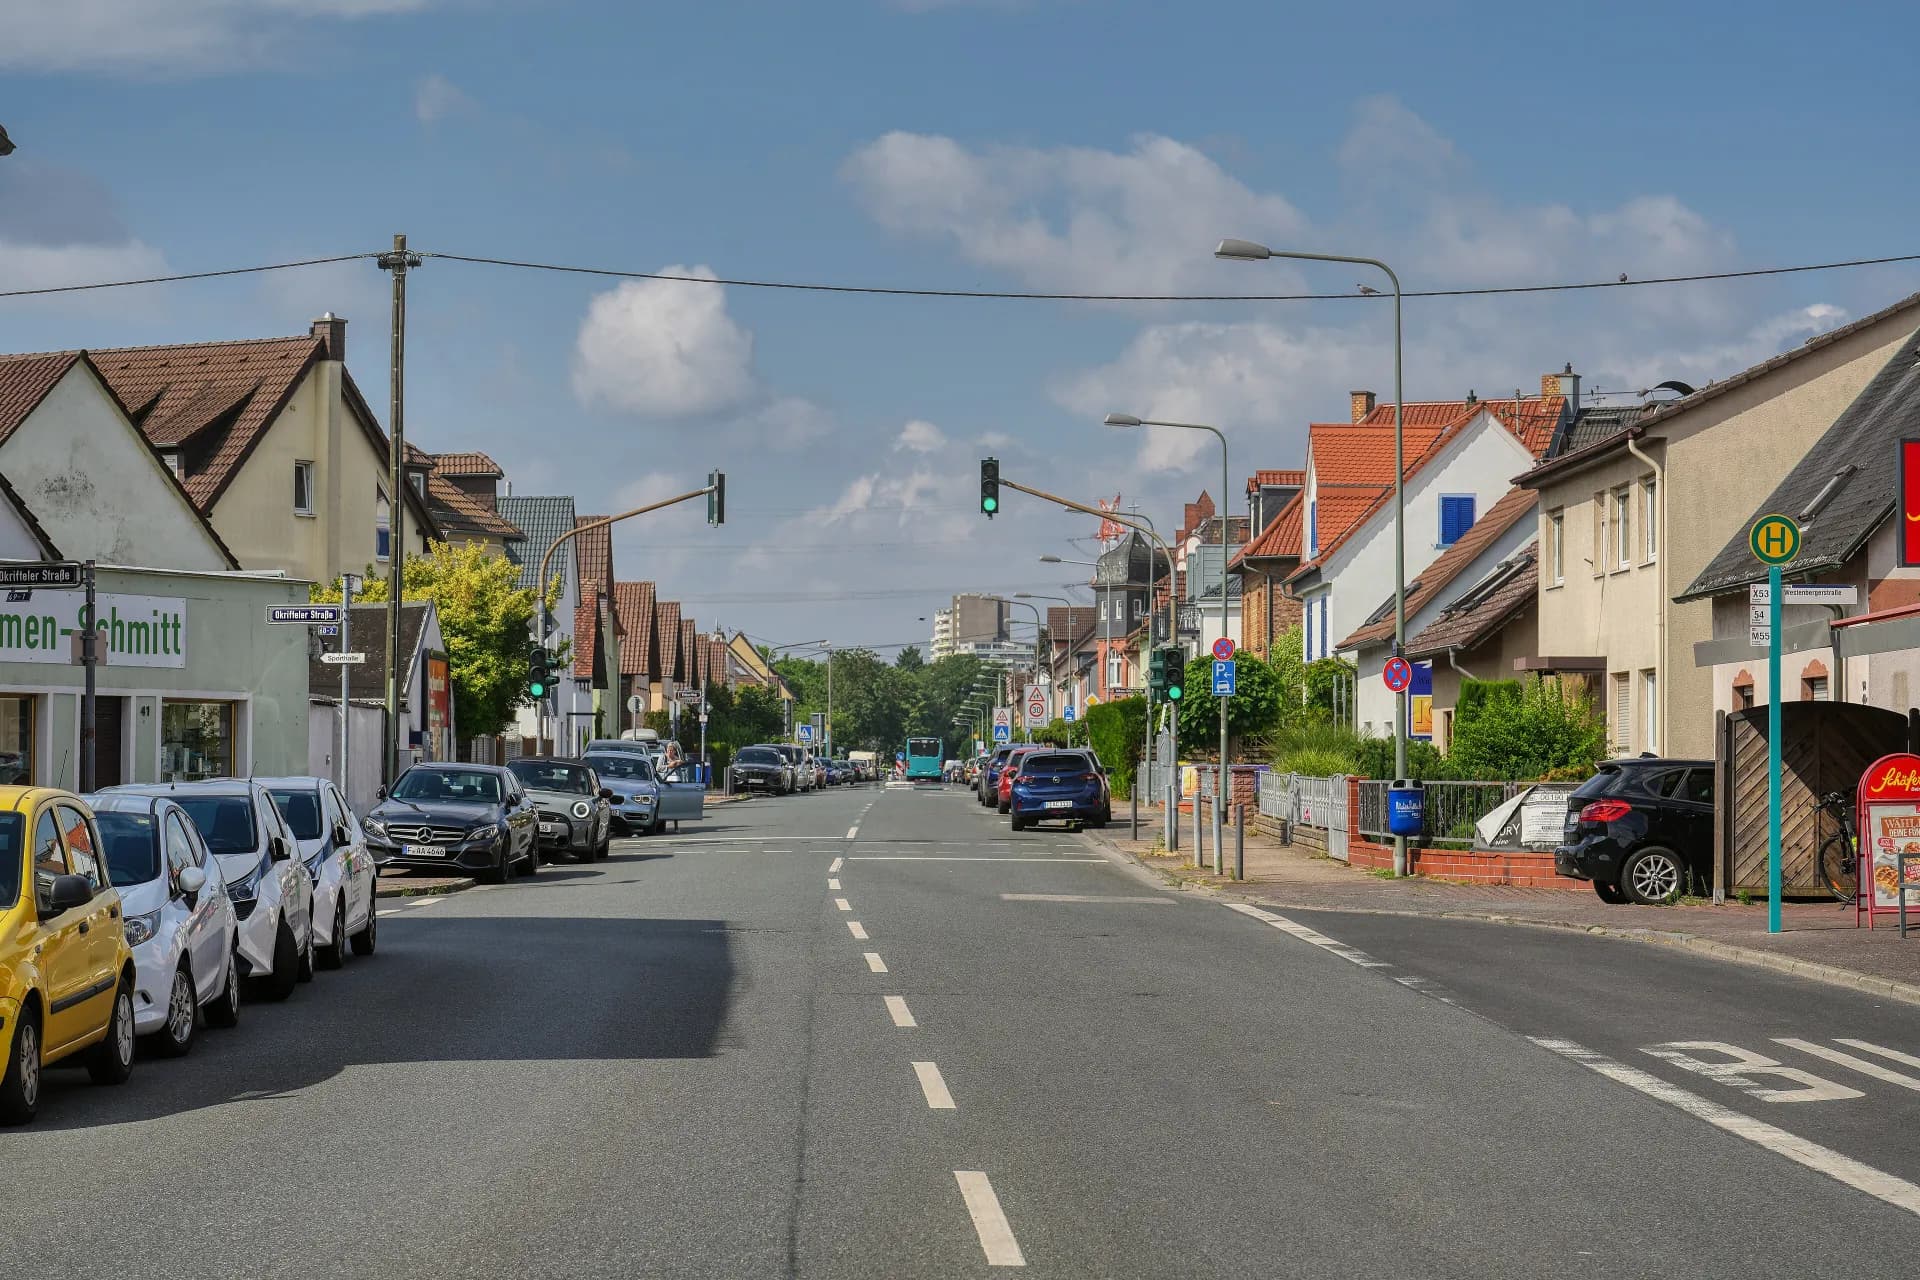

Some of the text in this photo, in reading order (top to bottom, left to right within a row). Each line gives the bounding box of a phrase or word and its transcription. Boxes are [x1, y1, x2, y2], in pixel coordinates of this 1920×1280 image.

[1766, 526, 1785, 554] H
[42, 569, 70, 582] Straße
[1753, 589, 1769, 598] X53
[275, 610, 333, 620] Okriffeler Straße
[1754, 610, 1764, 619] 54
[1751, 632, 1770, 640] M55
[1216, 663, 1226, 677] P
[1032, 706, 1041, 714] 30
